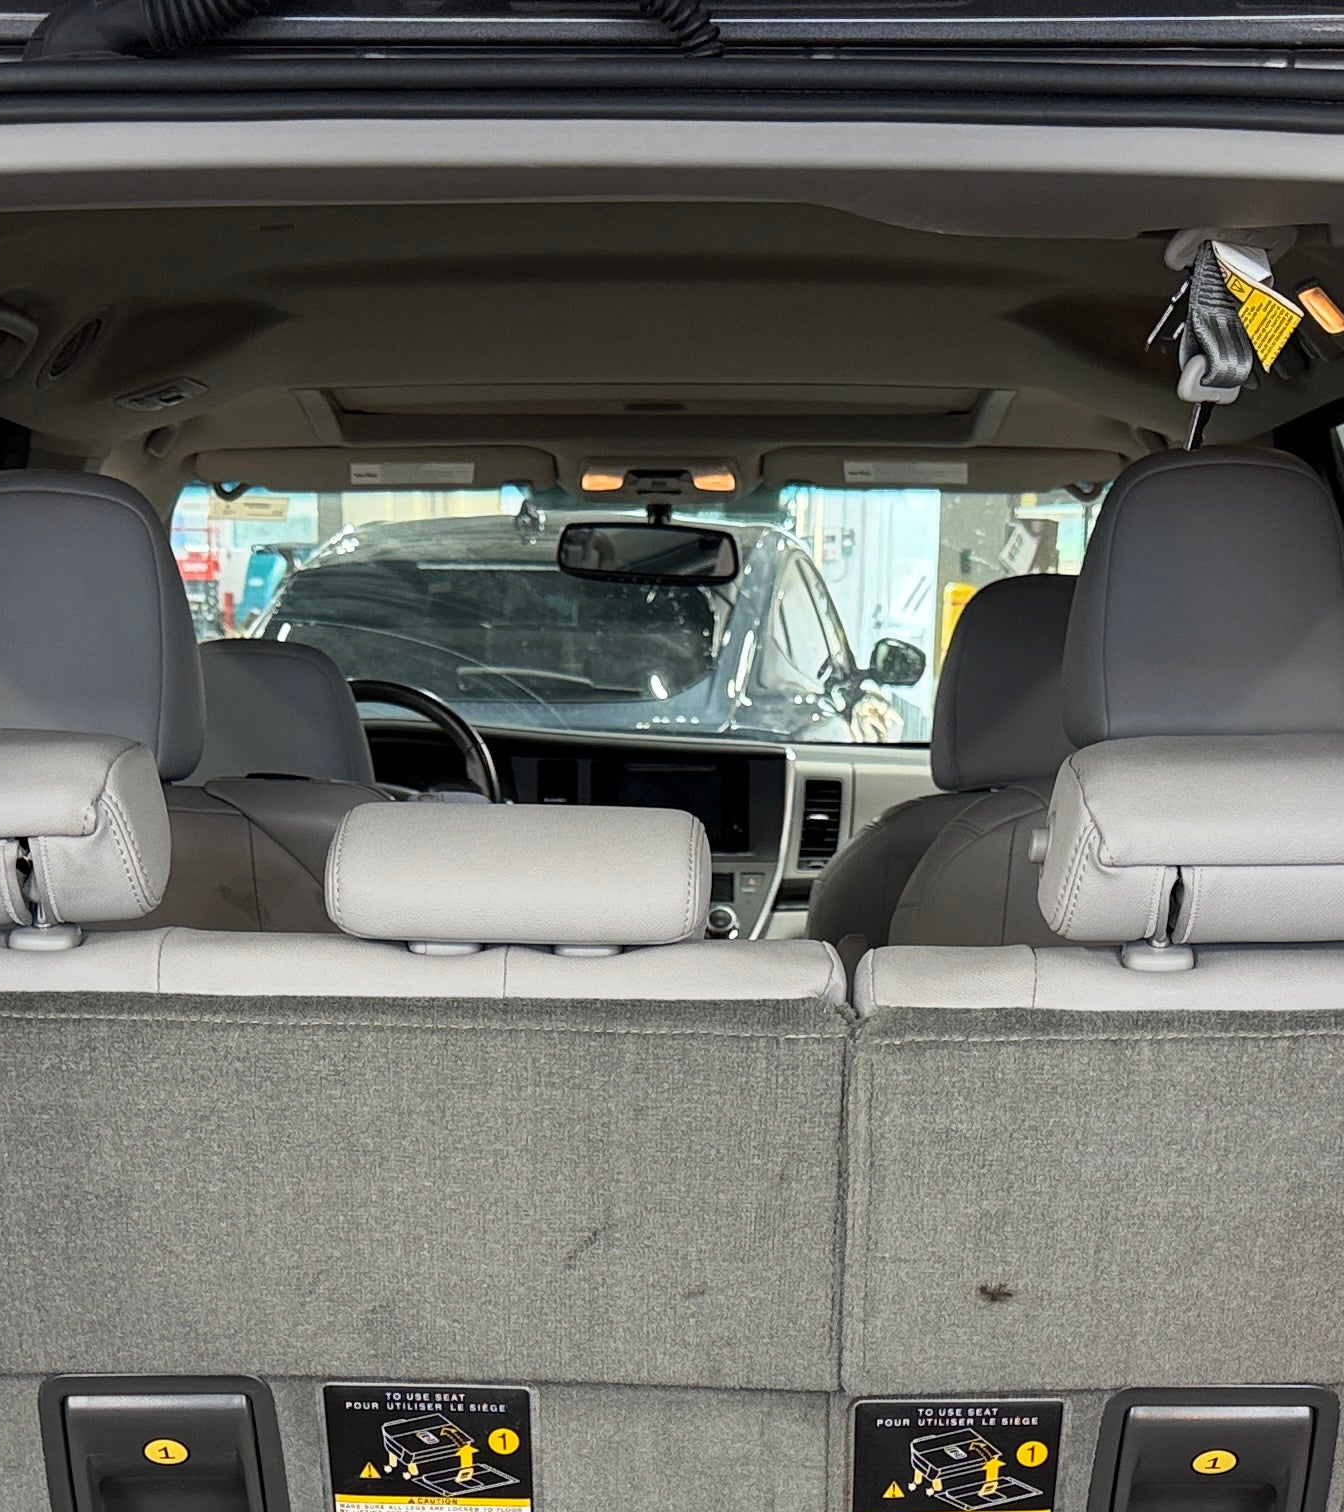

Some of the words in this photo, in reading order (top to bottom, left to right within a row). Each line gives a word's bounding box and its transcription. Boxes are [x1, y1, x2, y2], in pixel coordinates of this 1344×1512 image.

[385, 1392, 402, 1401] TO
[406, 1393, 430, 1402] USE
[434, 1393, 466, 1402] SEAT
[345, 1402, 379, 1411] POUR
[386, 1402, 441, 1412] UTILISER
[450, 1403, 464, 1412] LE
[469, 1401, 507, 1413] SIÈGE
[918, 1408, 934, 1416] TO
[939, 1408, 963, 1417] USE
[968, 1408, 999, 1417] SEAT
[876, 1418, 910, 1427] POUR
[917, 1418, 974, 1427] UTILISER
[982, 1417, 996, 1426] LE
[1001, 1415, 1039, 1426] SIÈGE
[499, 1433, 508, 1451] 1
[158, 1446, 176, 1460] 1
[1026, 1445, 1036, 1462] 1
[1205, 1456, 1221, 1470] 1
[418, 1497, 458, 1505] CAUTION
